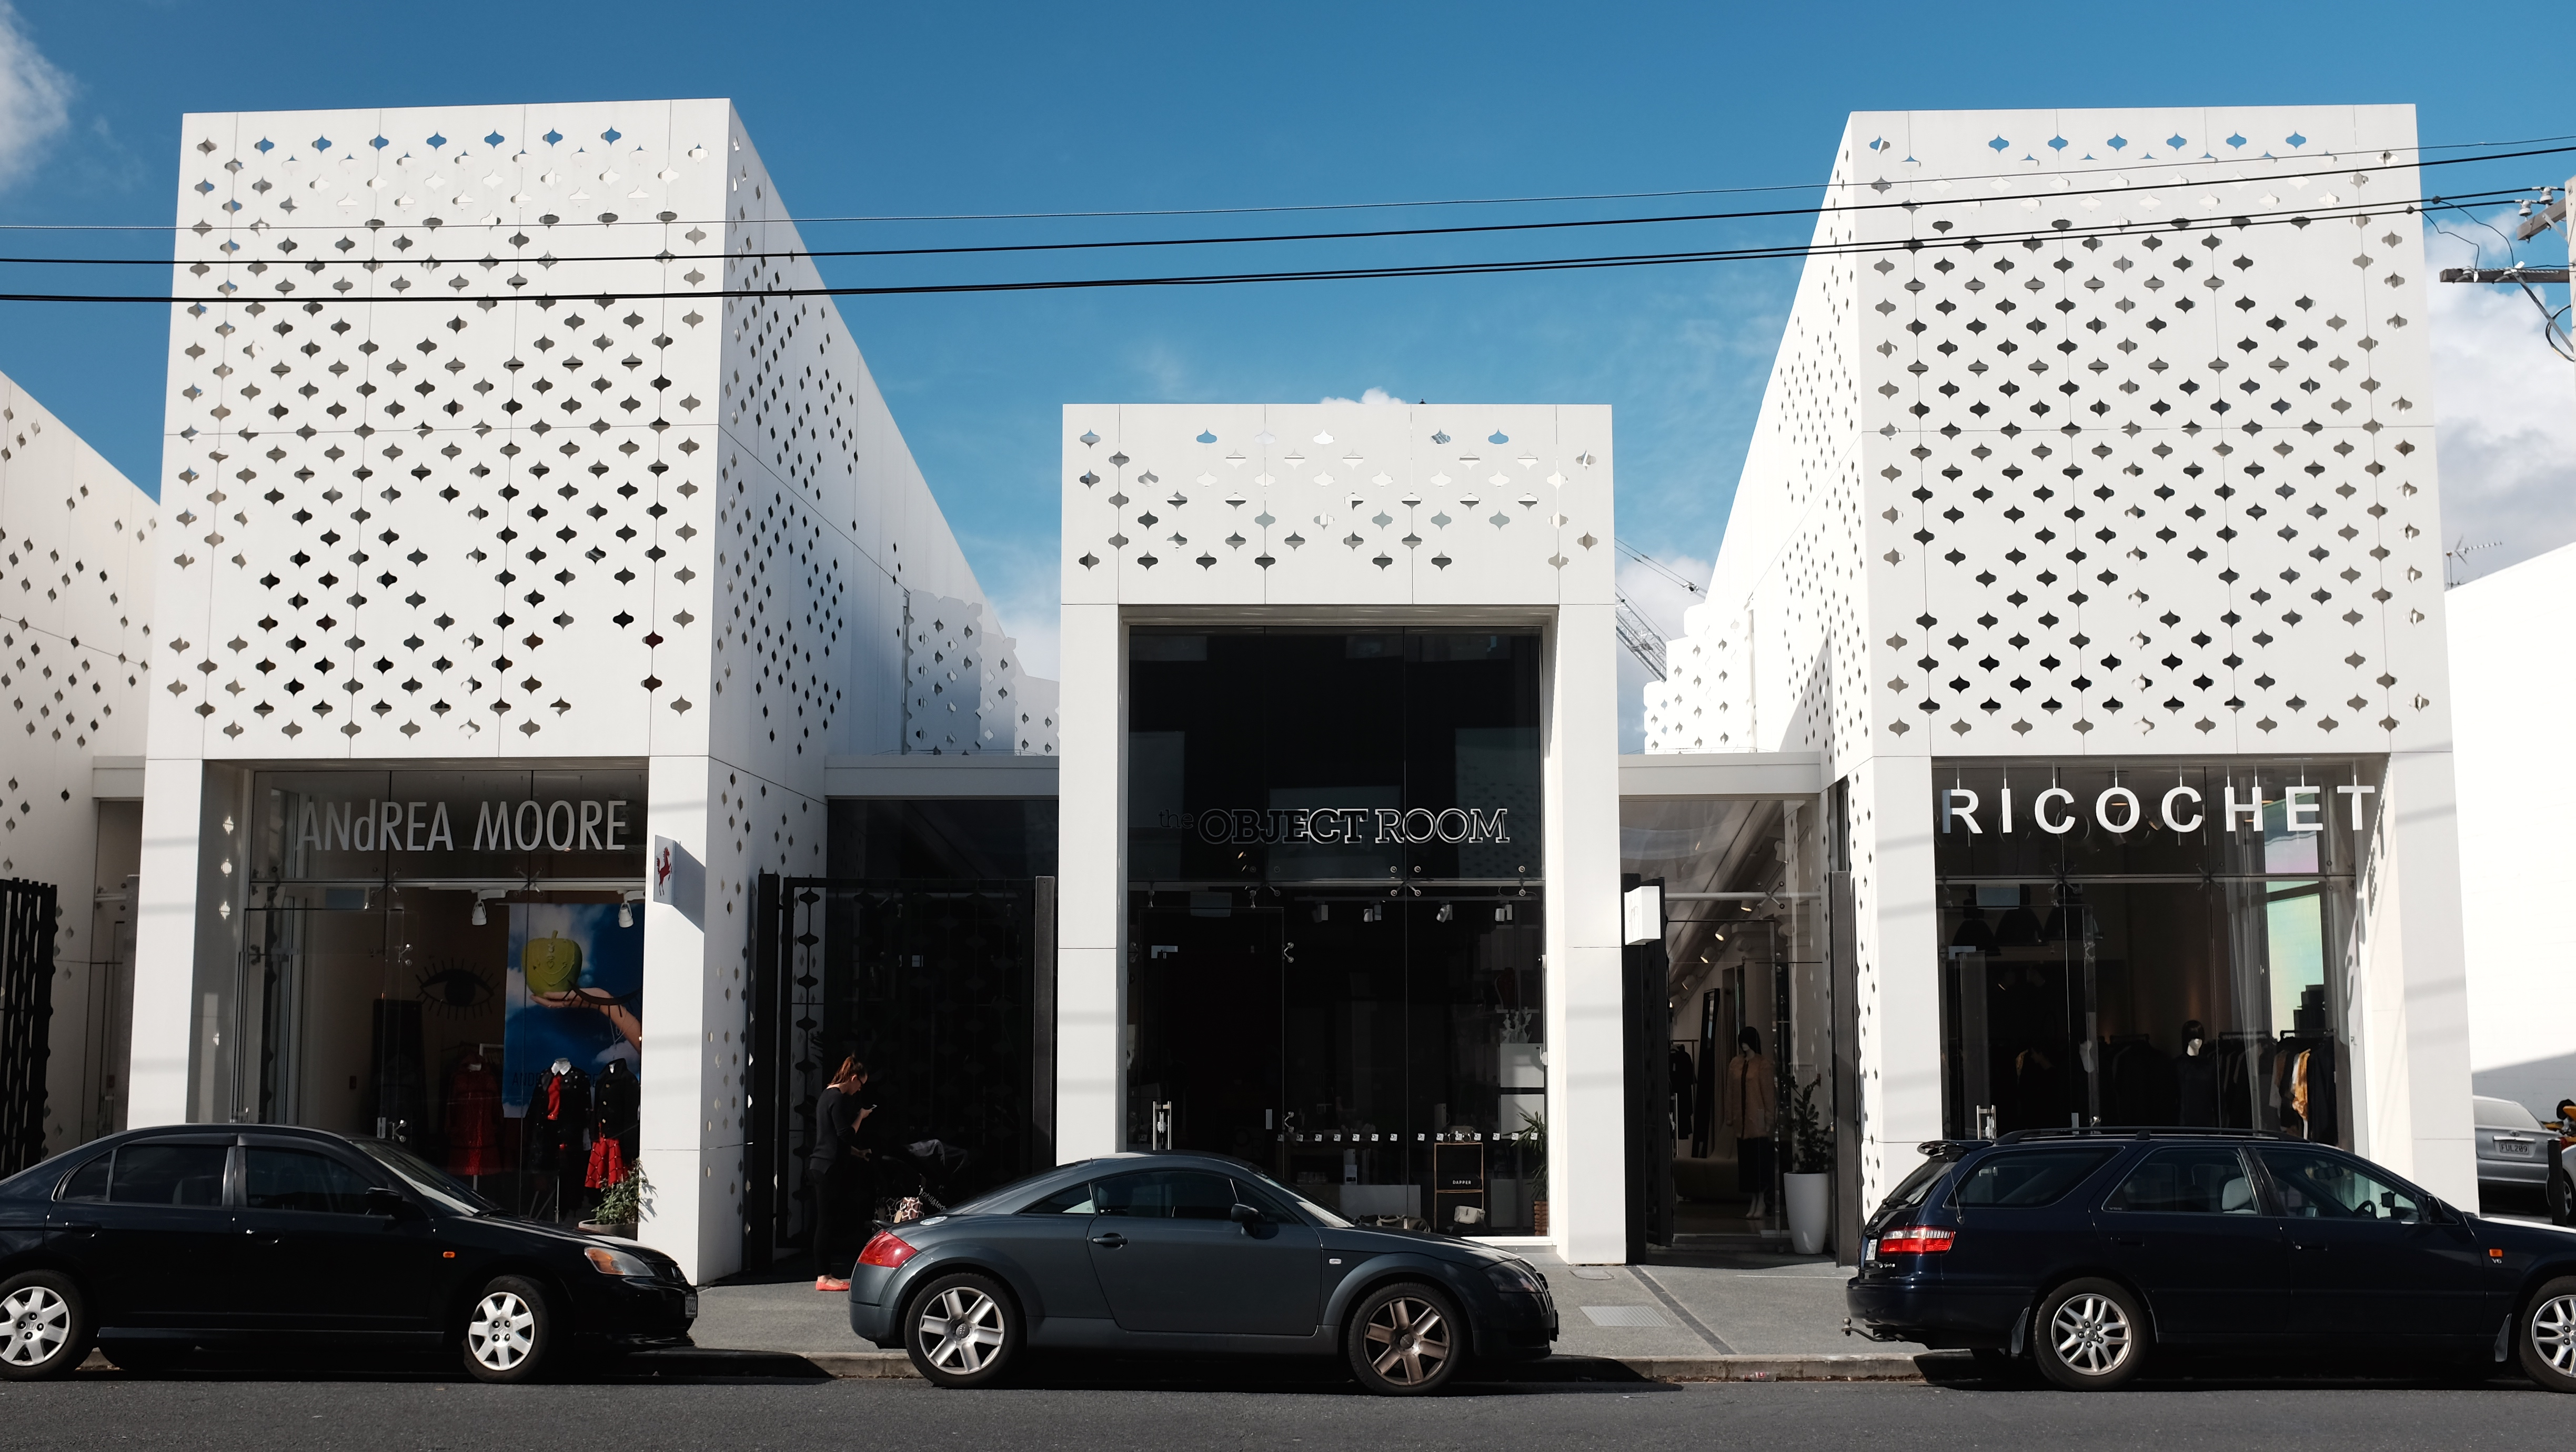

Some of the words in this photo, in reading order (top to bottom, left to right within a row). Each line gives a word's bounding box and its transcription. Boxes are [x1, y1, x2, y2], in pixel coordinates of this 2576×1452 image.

[296, 798, 454, 852] ANdREA
[473, 800, 628, 851] MOORE
[1158, 809, 1194, 829] the
[1198, 808, 1369, 844] OBJECT
[1375, 808, 1510, 844] ROOM
[1941, 785, 2376, 834] RICOCHET
[2501, 1143, 2528, 1153] FUL209
